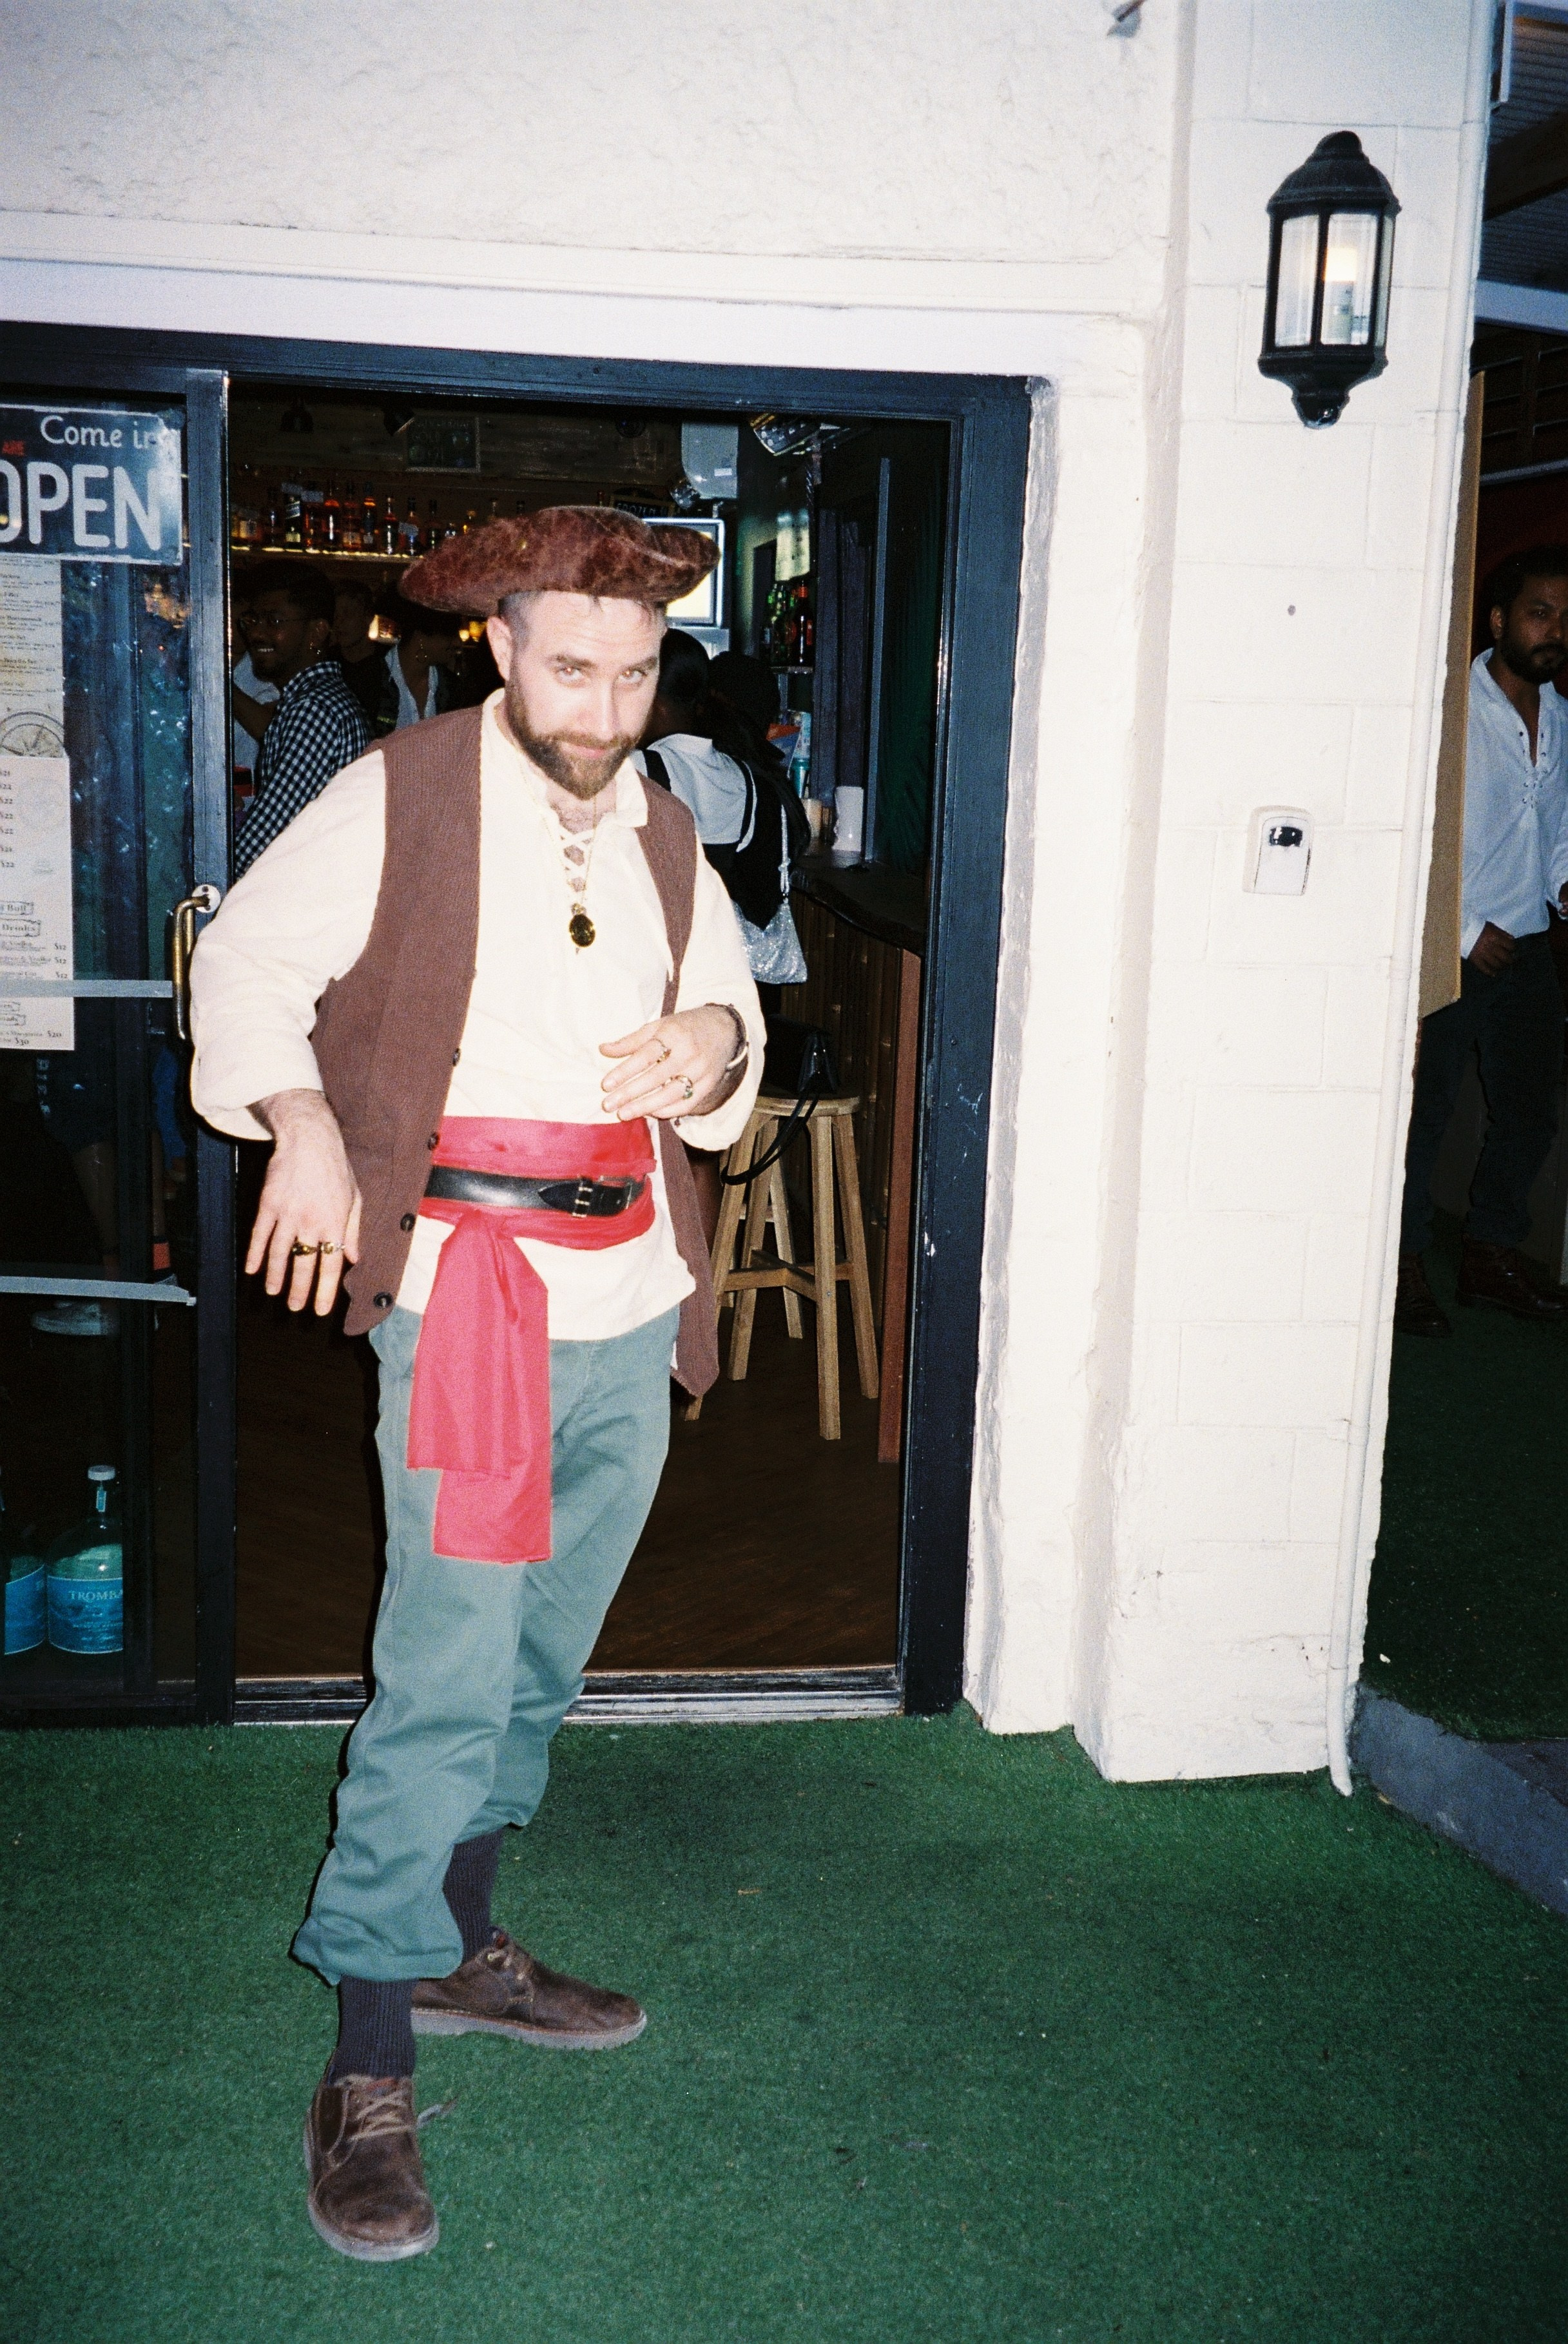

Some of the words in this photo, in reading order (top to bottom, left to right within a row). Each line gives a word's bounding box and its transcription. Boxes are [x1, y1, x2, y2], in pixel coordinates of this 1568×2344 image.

[40, 414, 123, 449] Come
[54, 942, 66, 951] $12
[15, 1037, 29, 1046] $30
